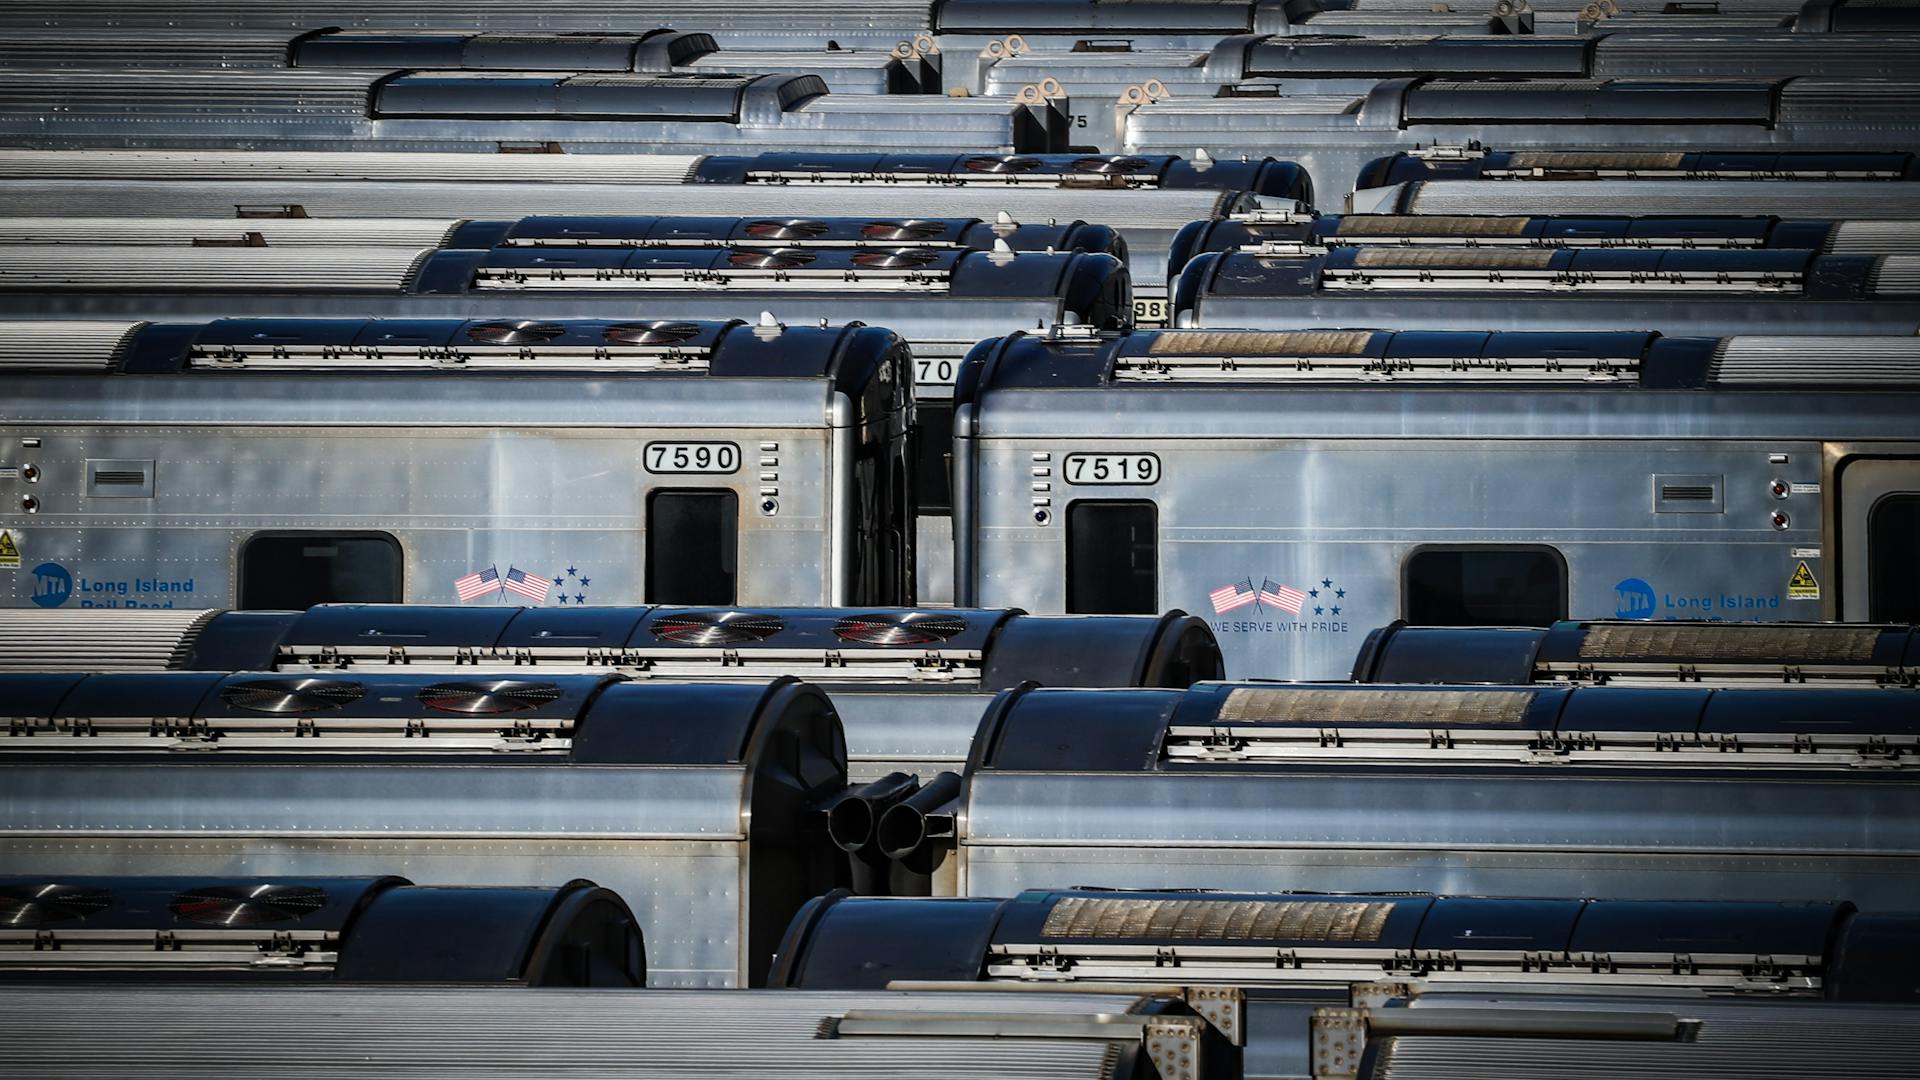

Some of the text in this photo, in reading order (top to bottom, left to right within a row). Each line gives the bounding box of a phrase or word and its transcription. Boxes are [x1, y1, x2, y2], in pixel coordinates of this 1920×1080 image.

[1135, 302, 1168, 317] 98
[918, 361, 952, 380] 70
[652, 447, 732, 469] 7590
[1072, 458, 1152, 480] 7519
[81, 578, 194, 595] Long Island
[1664, 594, 1779, 611] Long Island
[1210, 622, 1348, 632] WE SERVE WITH PRIDE
